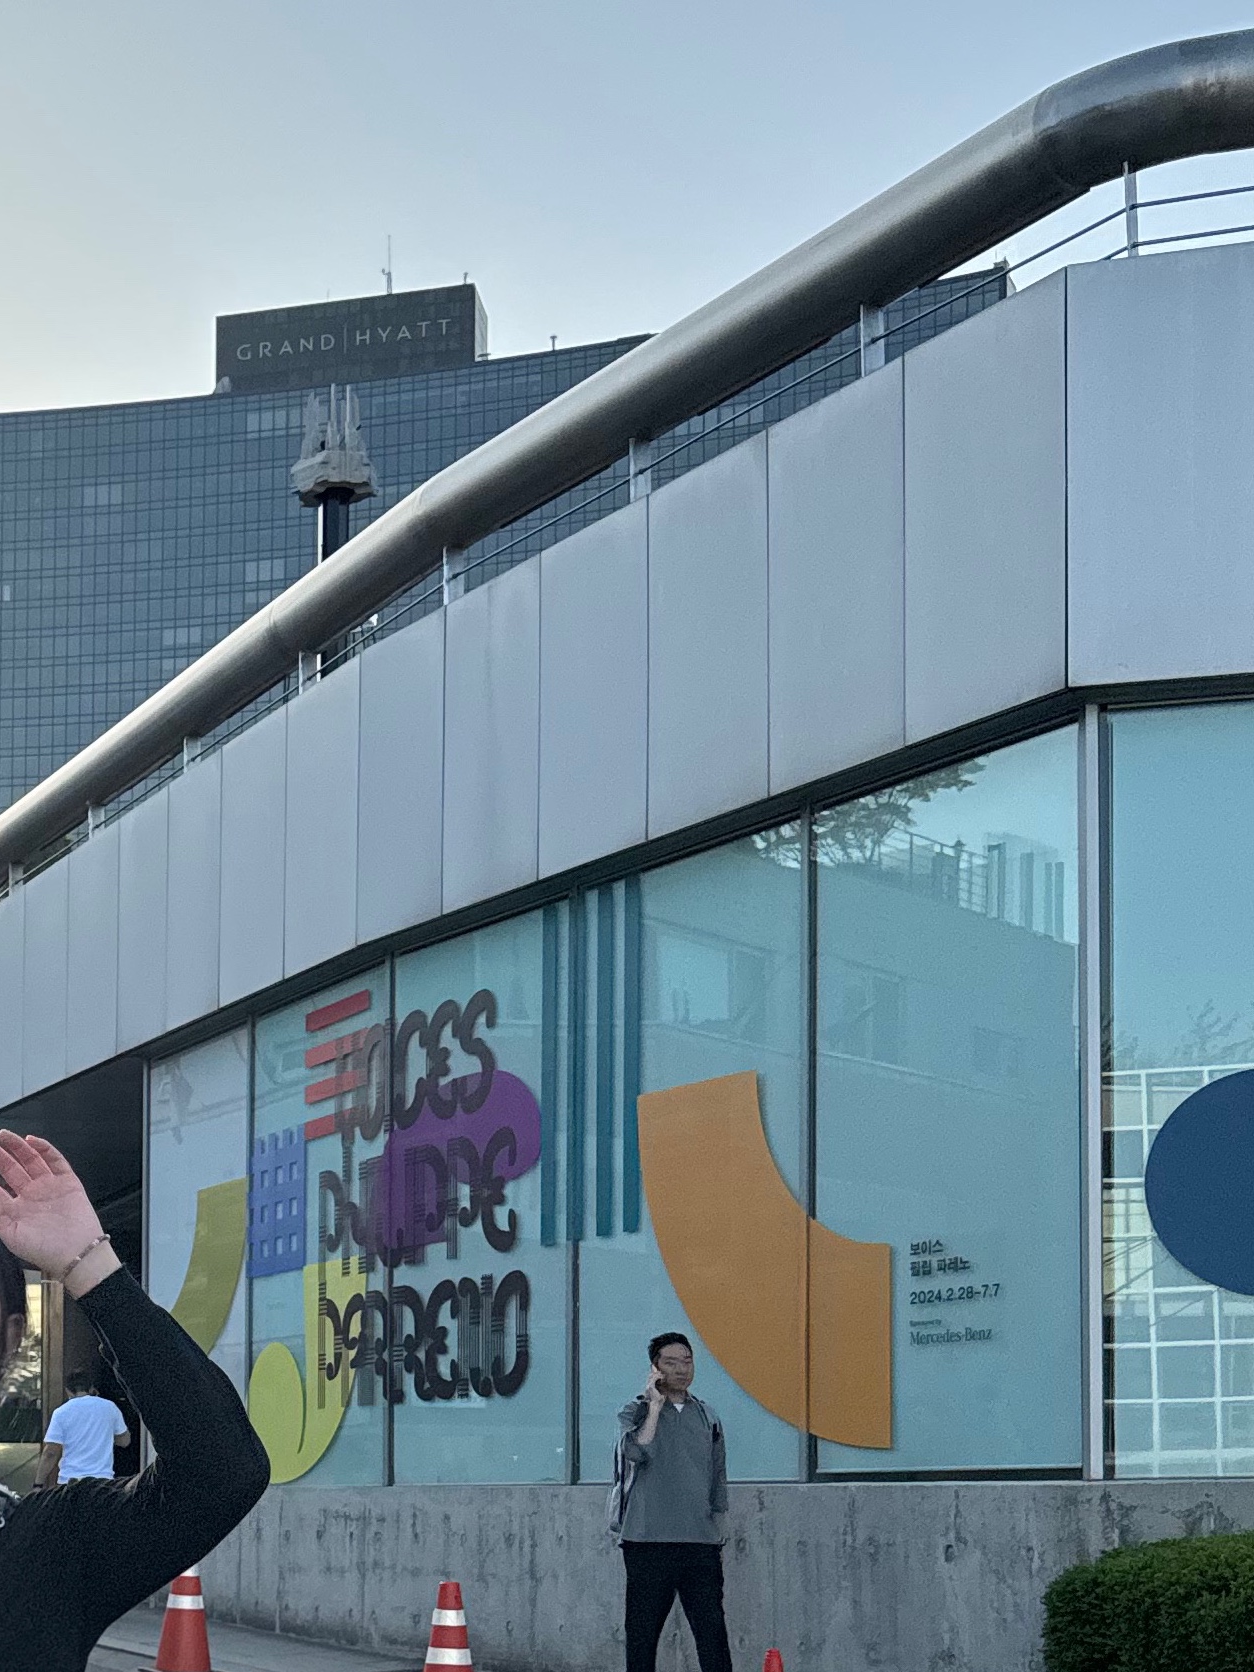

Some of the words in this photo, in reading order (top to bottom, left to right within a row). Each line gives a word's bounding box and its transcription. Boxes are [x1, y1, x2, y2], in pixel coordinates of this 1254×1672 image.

[236, 333, 336, 361] GRAND
[356, 319, 452, 346] HYATT
[909, 1239, 944, 1256] 보이스
[910, 1327, 993, 1346] Mercedes-Benz
